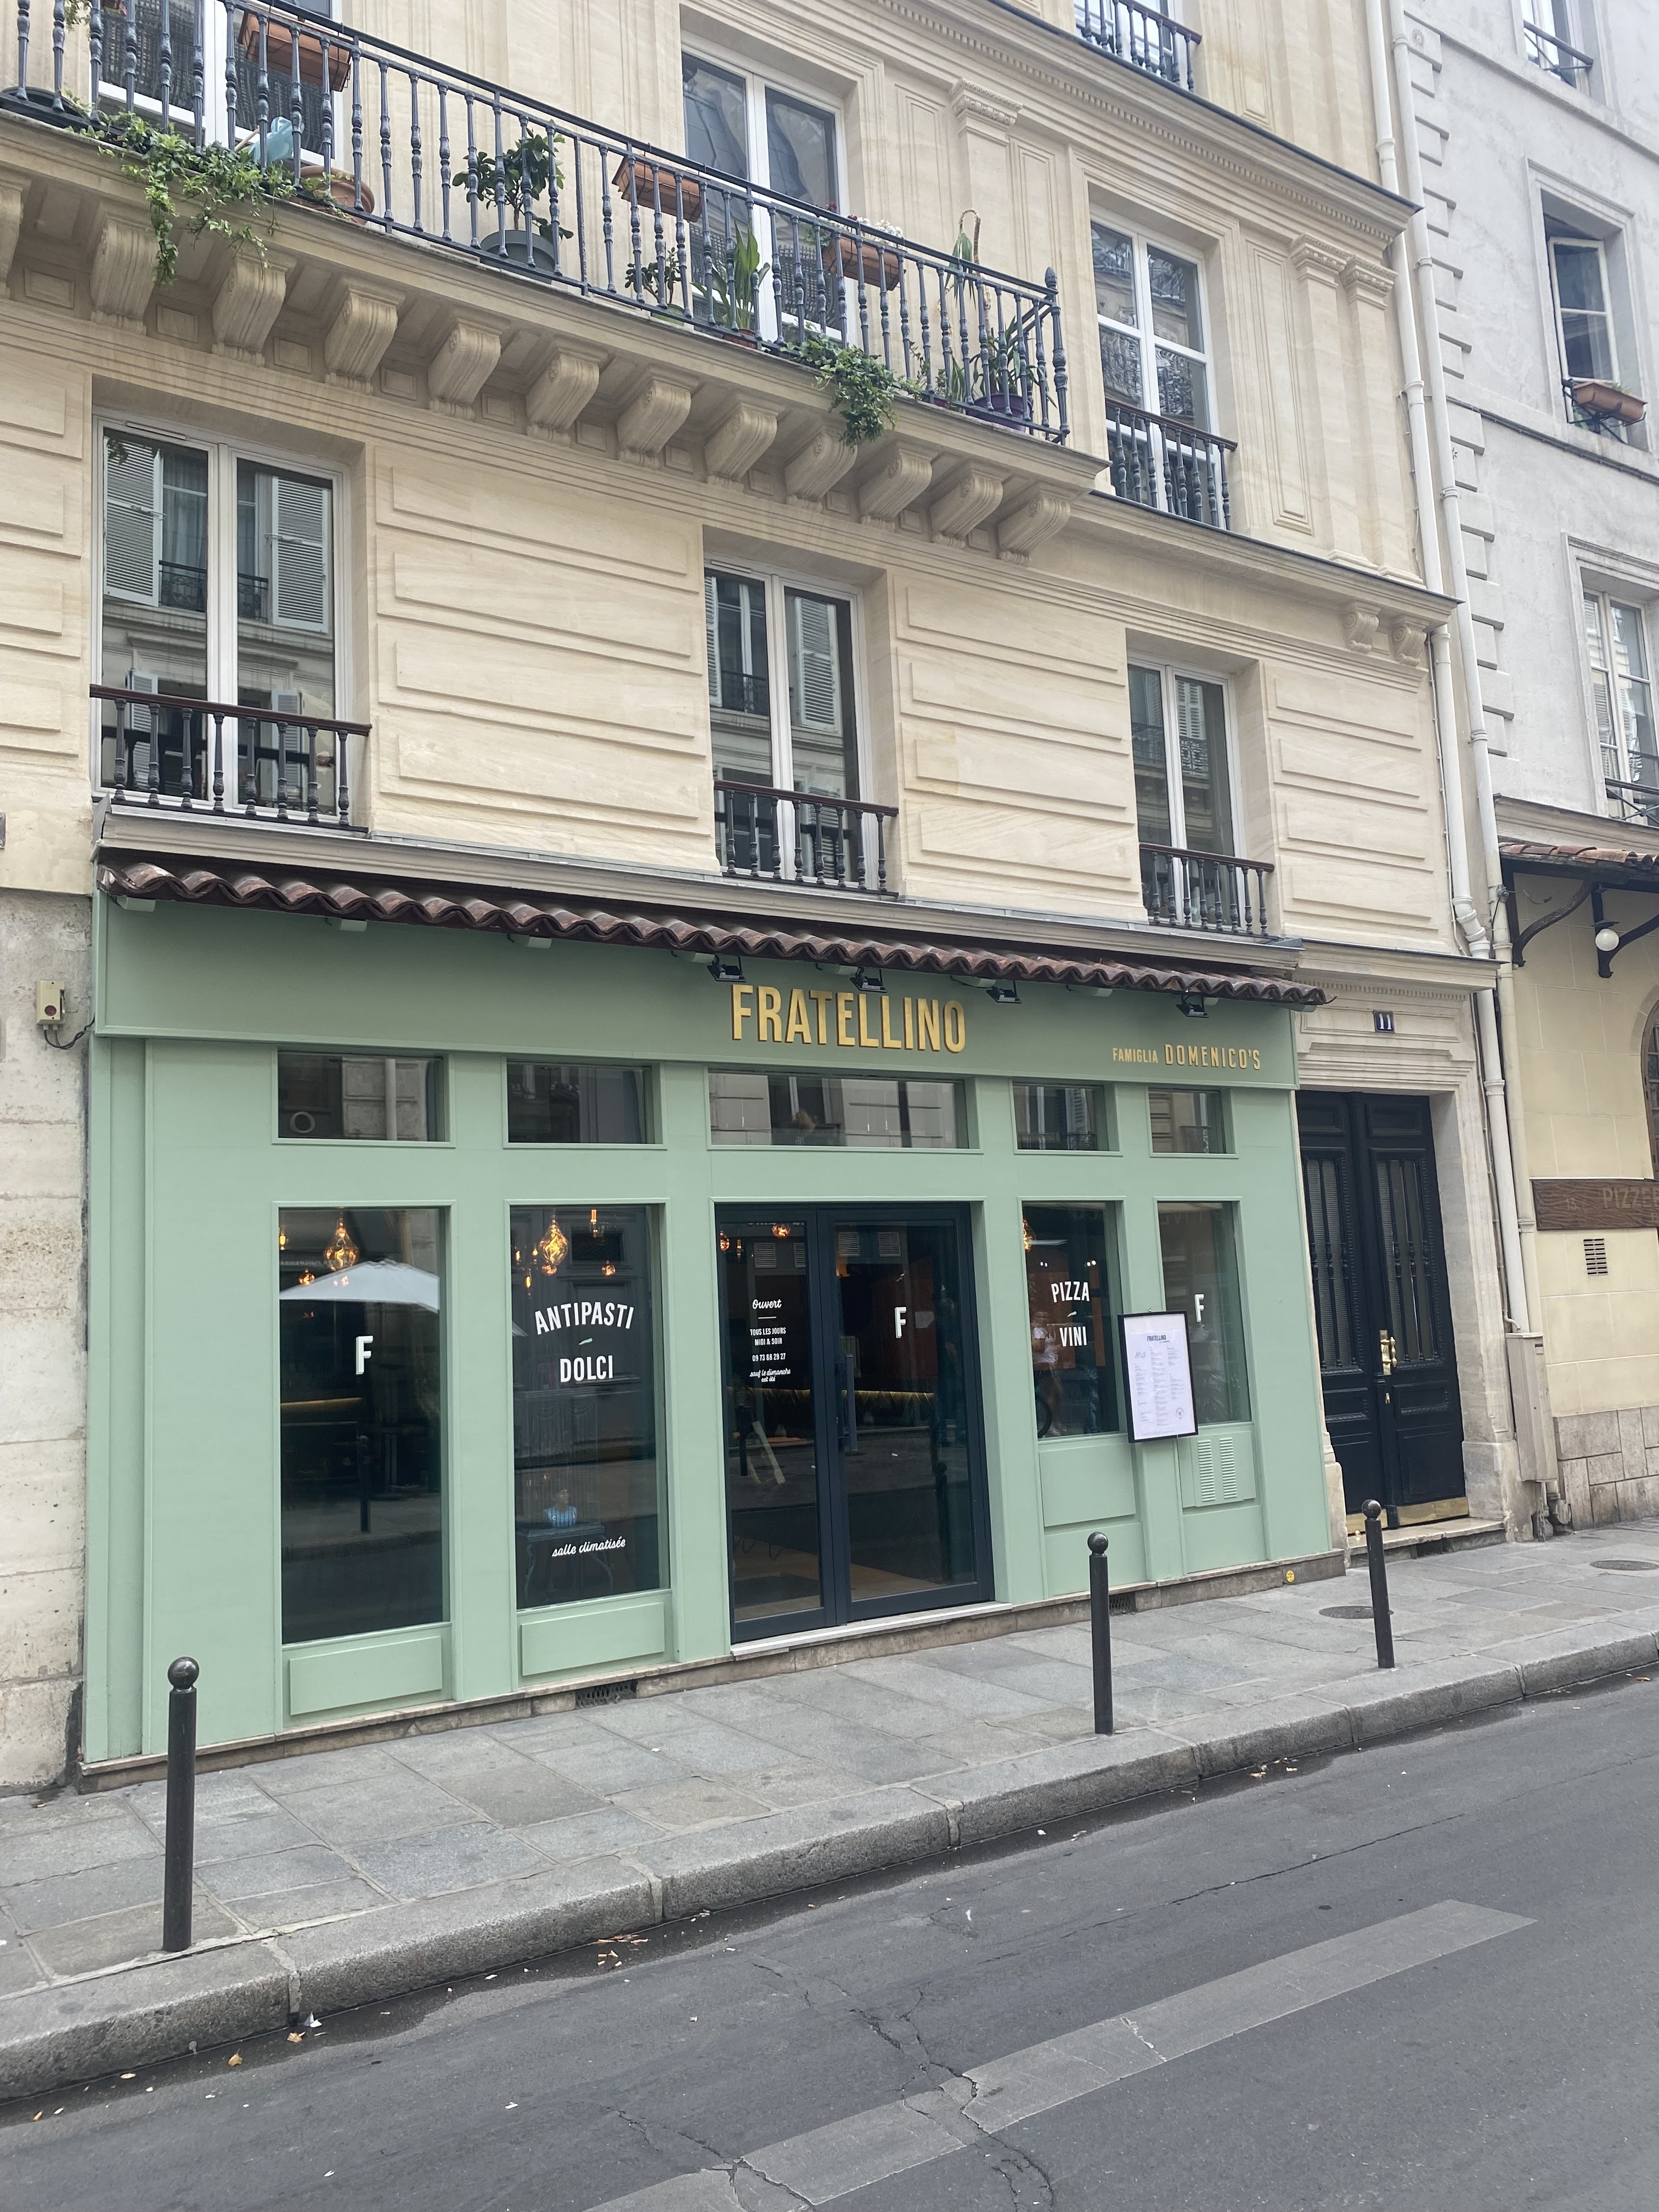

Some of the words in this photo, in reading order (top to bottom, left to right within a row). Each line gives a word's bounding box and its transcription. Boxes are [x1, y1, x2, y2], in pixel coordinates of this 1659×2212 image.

[731, 984, 966, 1053] FRATELLINO
[1379, 1013, 1391, 1029] 11
[1113, 1047, 1158, 1063] FAMIGLIA
[1164, 1044, 1260, 1070] DOMENICO'S
[752, 1299, 782, 1310] Ouvert
[1051, 1281, 1090, 1303] PIZZA
[535, 1301, 634, 1335] ANTIPASTI
[1194, 1294, 1204, 1322] F
[894, 1306, 906, 1338] F
[1059, 1326, 1087, 1347] VINI
[356, 1335, 373, 1375] F
[560, 1355, 613, 1383] DOLCI
[749, 1369, 761, 1378] sauf
[766, 1368, 791, 1376] dimanche
[552, 1544, 577, 1557] salle
[579, 1536, 626, 1554] climatisée
